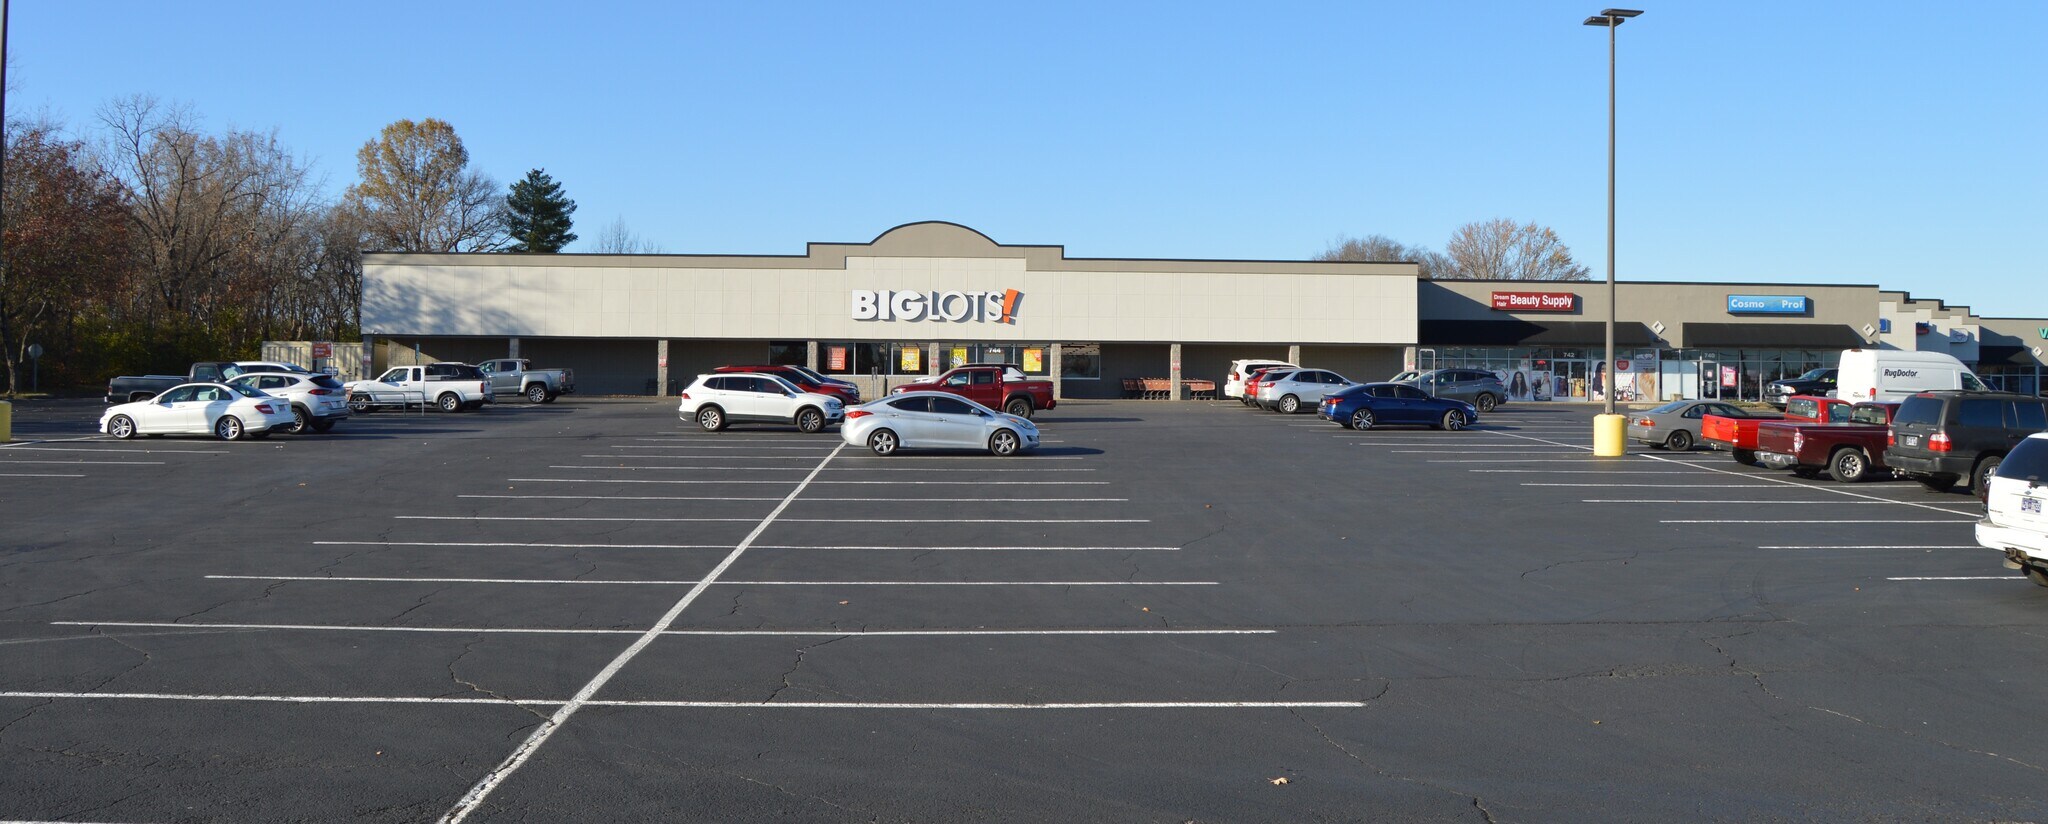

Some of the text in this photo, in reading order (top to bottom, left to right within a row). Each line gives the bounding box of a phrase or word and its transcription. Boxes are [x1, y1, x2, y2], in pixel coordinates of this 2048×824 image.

[1510, 294, 1573, 308] Beauty Supply
[1731, 298, 1804, 309] Cosmo Prof
[2037, 327, 2048, 340] V
